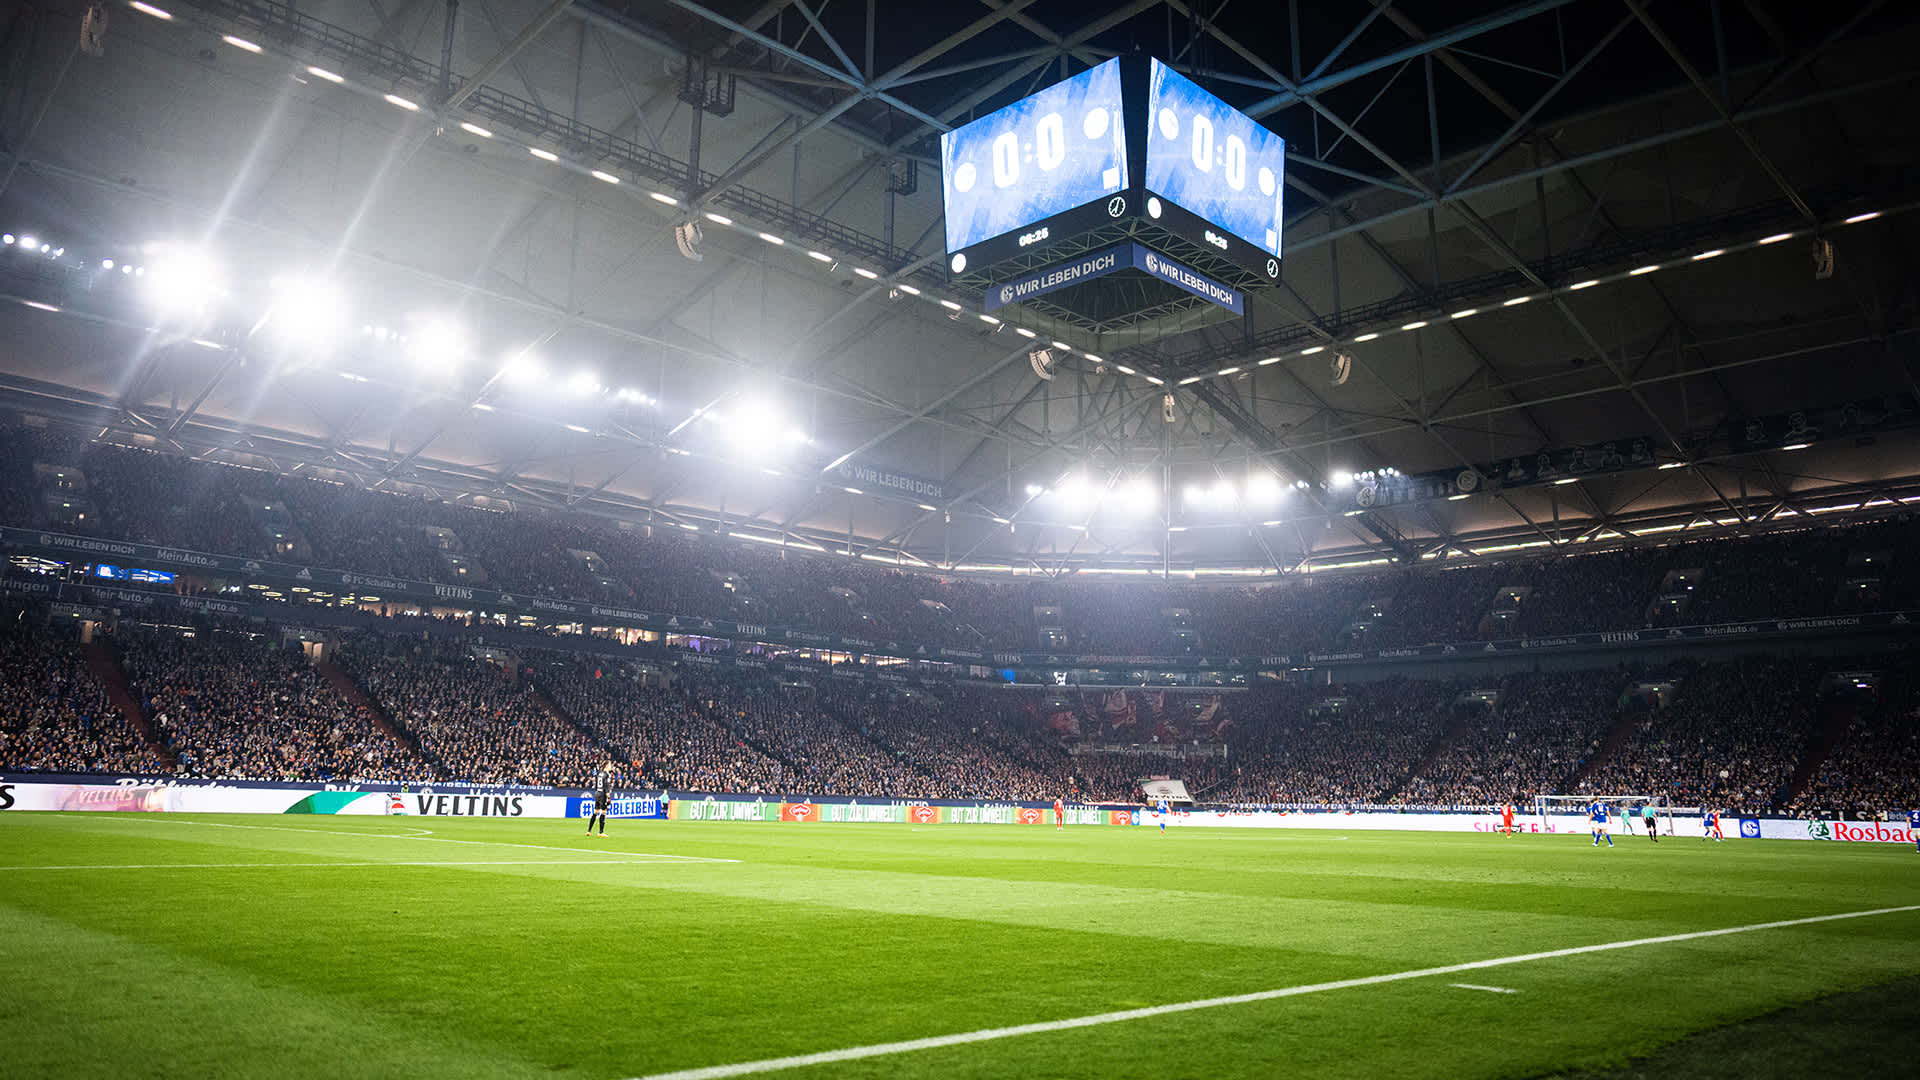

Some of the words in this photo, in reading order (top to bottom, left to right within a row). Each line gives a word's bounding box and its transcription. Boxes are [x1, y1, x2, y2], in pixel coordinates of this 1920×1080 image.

[1016, 279, 1040, 297] WIR
[1041, 265, 1081, 289] LEBEN
[1082, 253, 1115, 275] DICH
[1159, 260, 1179, 281] WIR
[1179, 270, 1209, 295] LEBEN
[1210, 284, 1233, 305] DICH
[854, 466, 877, 482] WIR
[879, 472, 916, 491] LEBEN
[916, 480, 943, 498] DICH
[54, 537, 74, 548] WIR
[75, 540, 109, 552] LEBEN
[110, 544, 136, 554] DICH
[435, 585, 473, 599] VELTINS
[737, 623, 767, 636] VELTINS
[1600, 632, 1640, 643] VELTINS
[79, 788, 136, 804] VELTINS
[417, 795, 523, 817] VELTINS
[583, 801, 655, 817] #RBLEIBEN
[689, 801, 709, 820] GUT
[709, 801, 728, 820] ZUR
[730, 801, 768, 821] UMWELT
